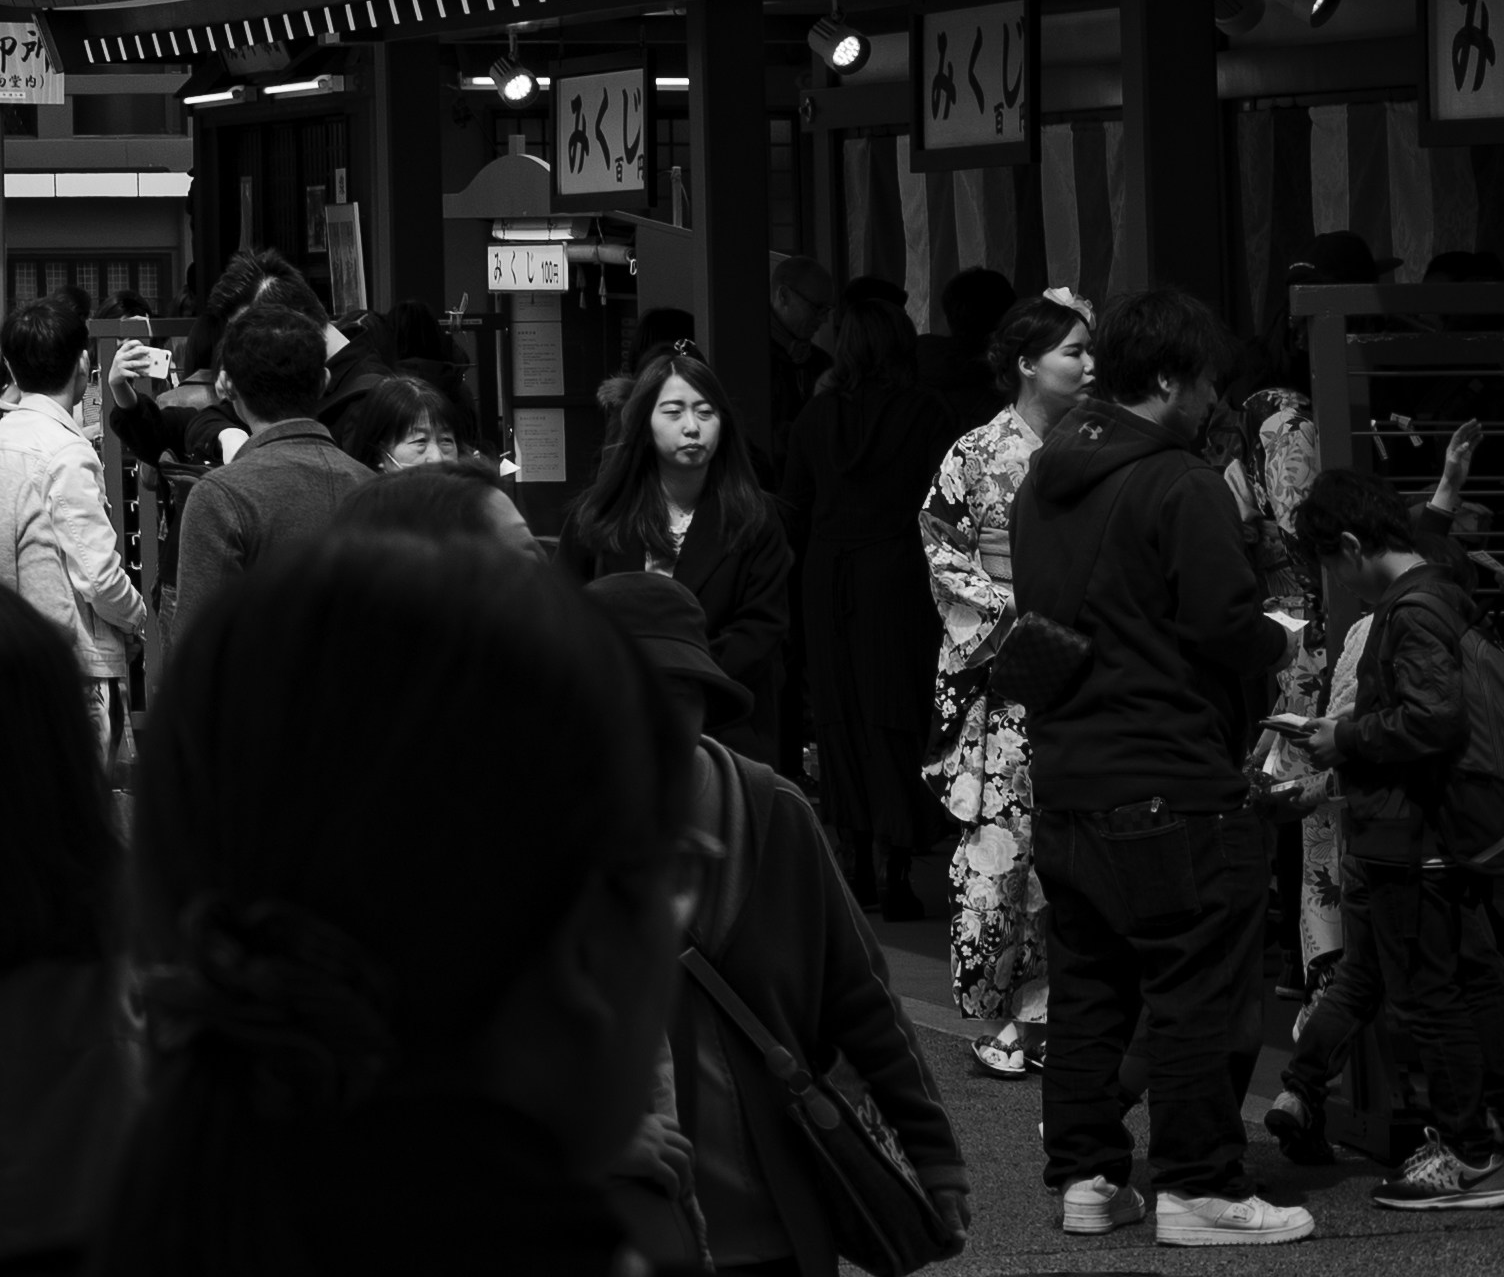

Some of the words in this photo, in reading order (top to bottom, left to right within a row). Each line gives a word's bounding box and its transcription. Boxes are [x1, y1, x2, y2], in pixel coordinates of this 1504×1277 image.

[932, 17, 1025, 121] みくじ
[569, 87, 642, 174] みくじ
[494, 250, 535, 285] みくじ
